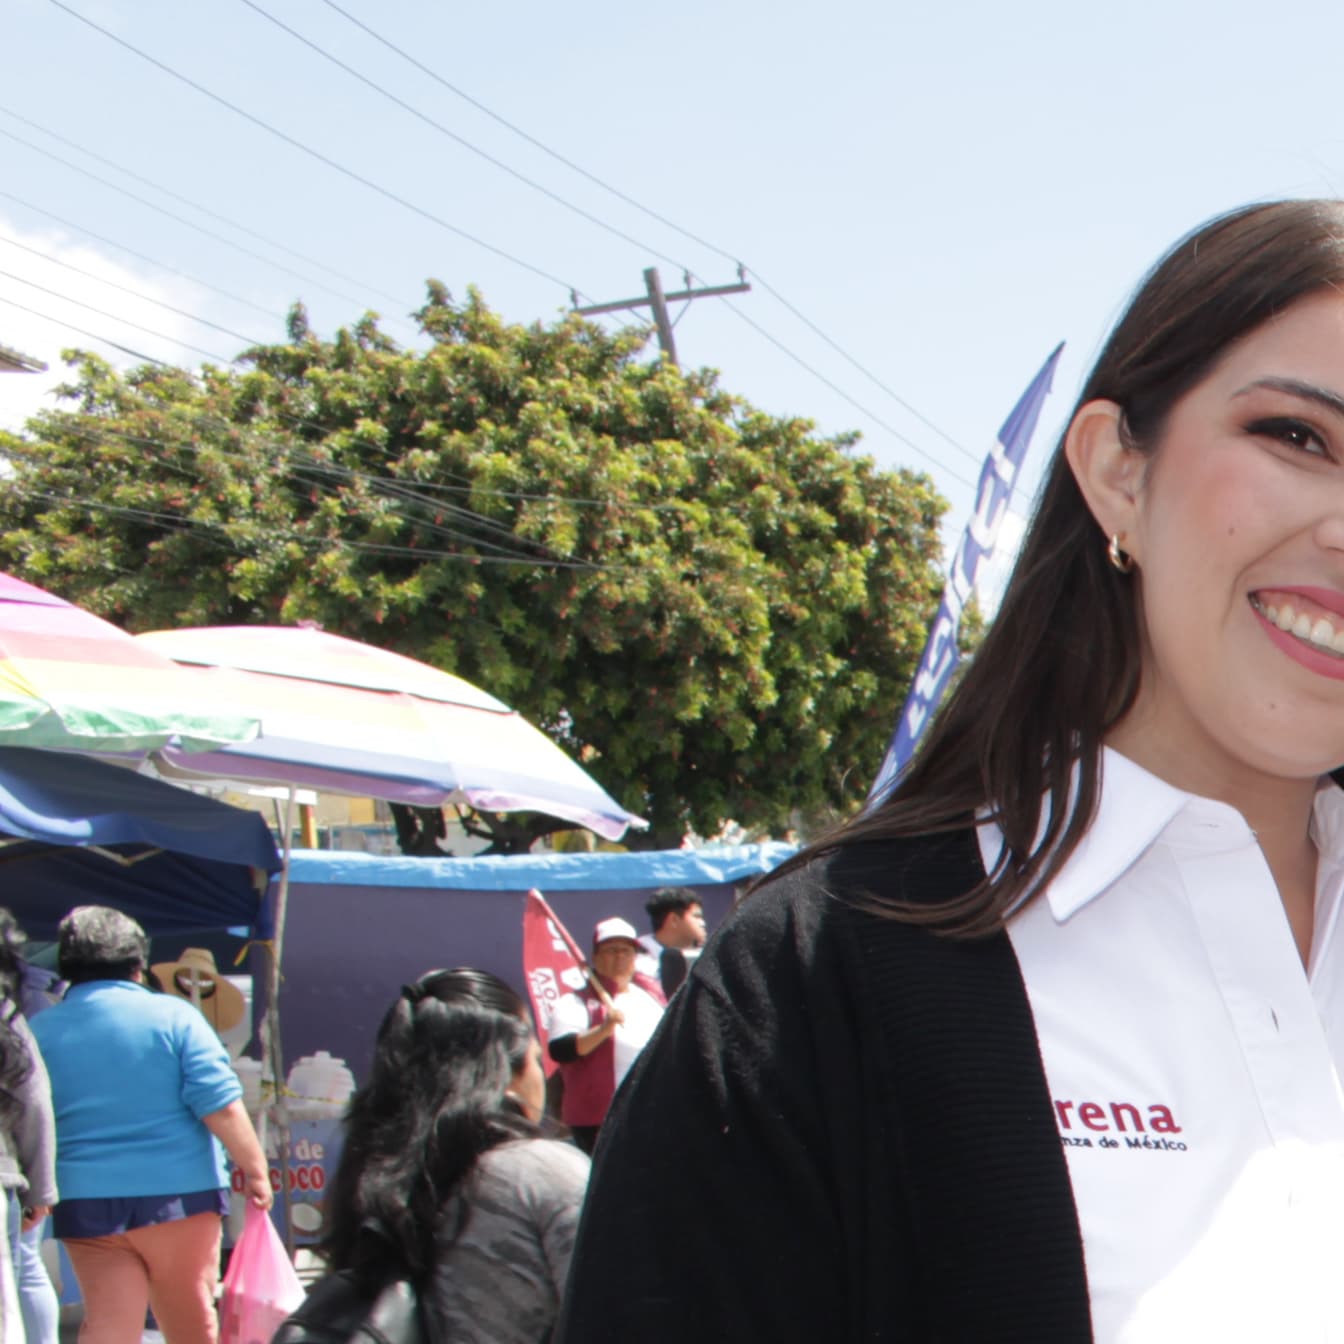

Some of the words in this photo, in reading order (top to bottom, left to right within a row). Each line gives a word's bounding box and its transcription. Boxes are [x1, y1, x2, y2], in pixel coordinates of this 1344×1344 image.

[1054, 1099, 1182, 1133] rena
[1099, 1136, 1119, 1149] de
[1125, 1134, 1187, 1152] México
